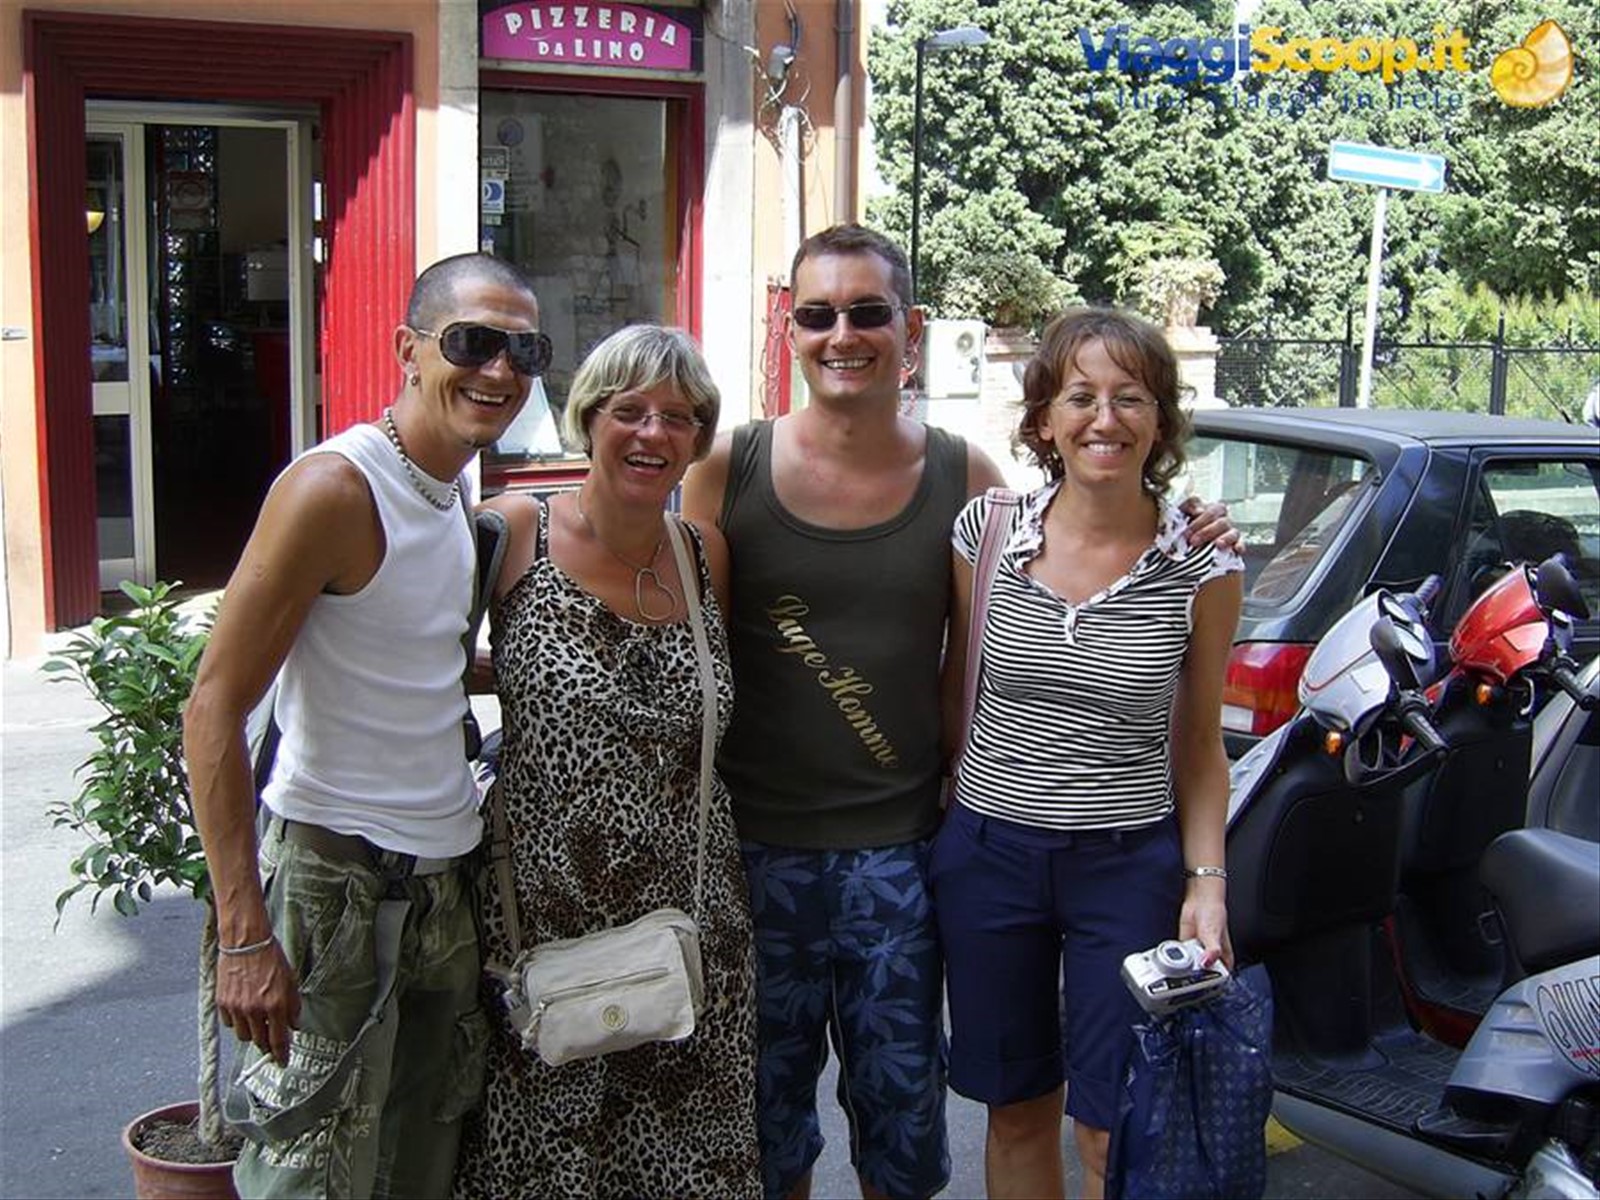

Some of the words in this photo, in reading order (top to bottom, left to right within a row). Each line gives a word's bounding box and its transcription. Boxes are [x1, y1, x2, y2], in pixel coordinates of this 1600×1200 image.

[504, 6, 677, 45] PIZZERIA
[538, 41, 564, 56] DA
[574, 39, 645, 61] LINO
[818, 666, 898, 769] Homme
